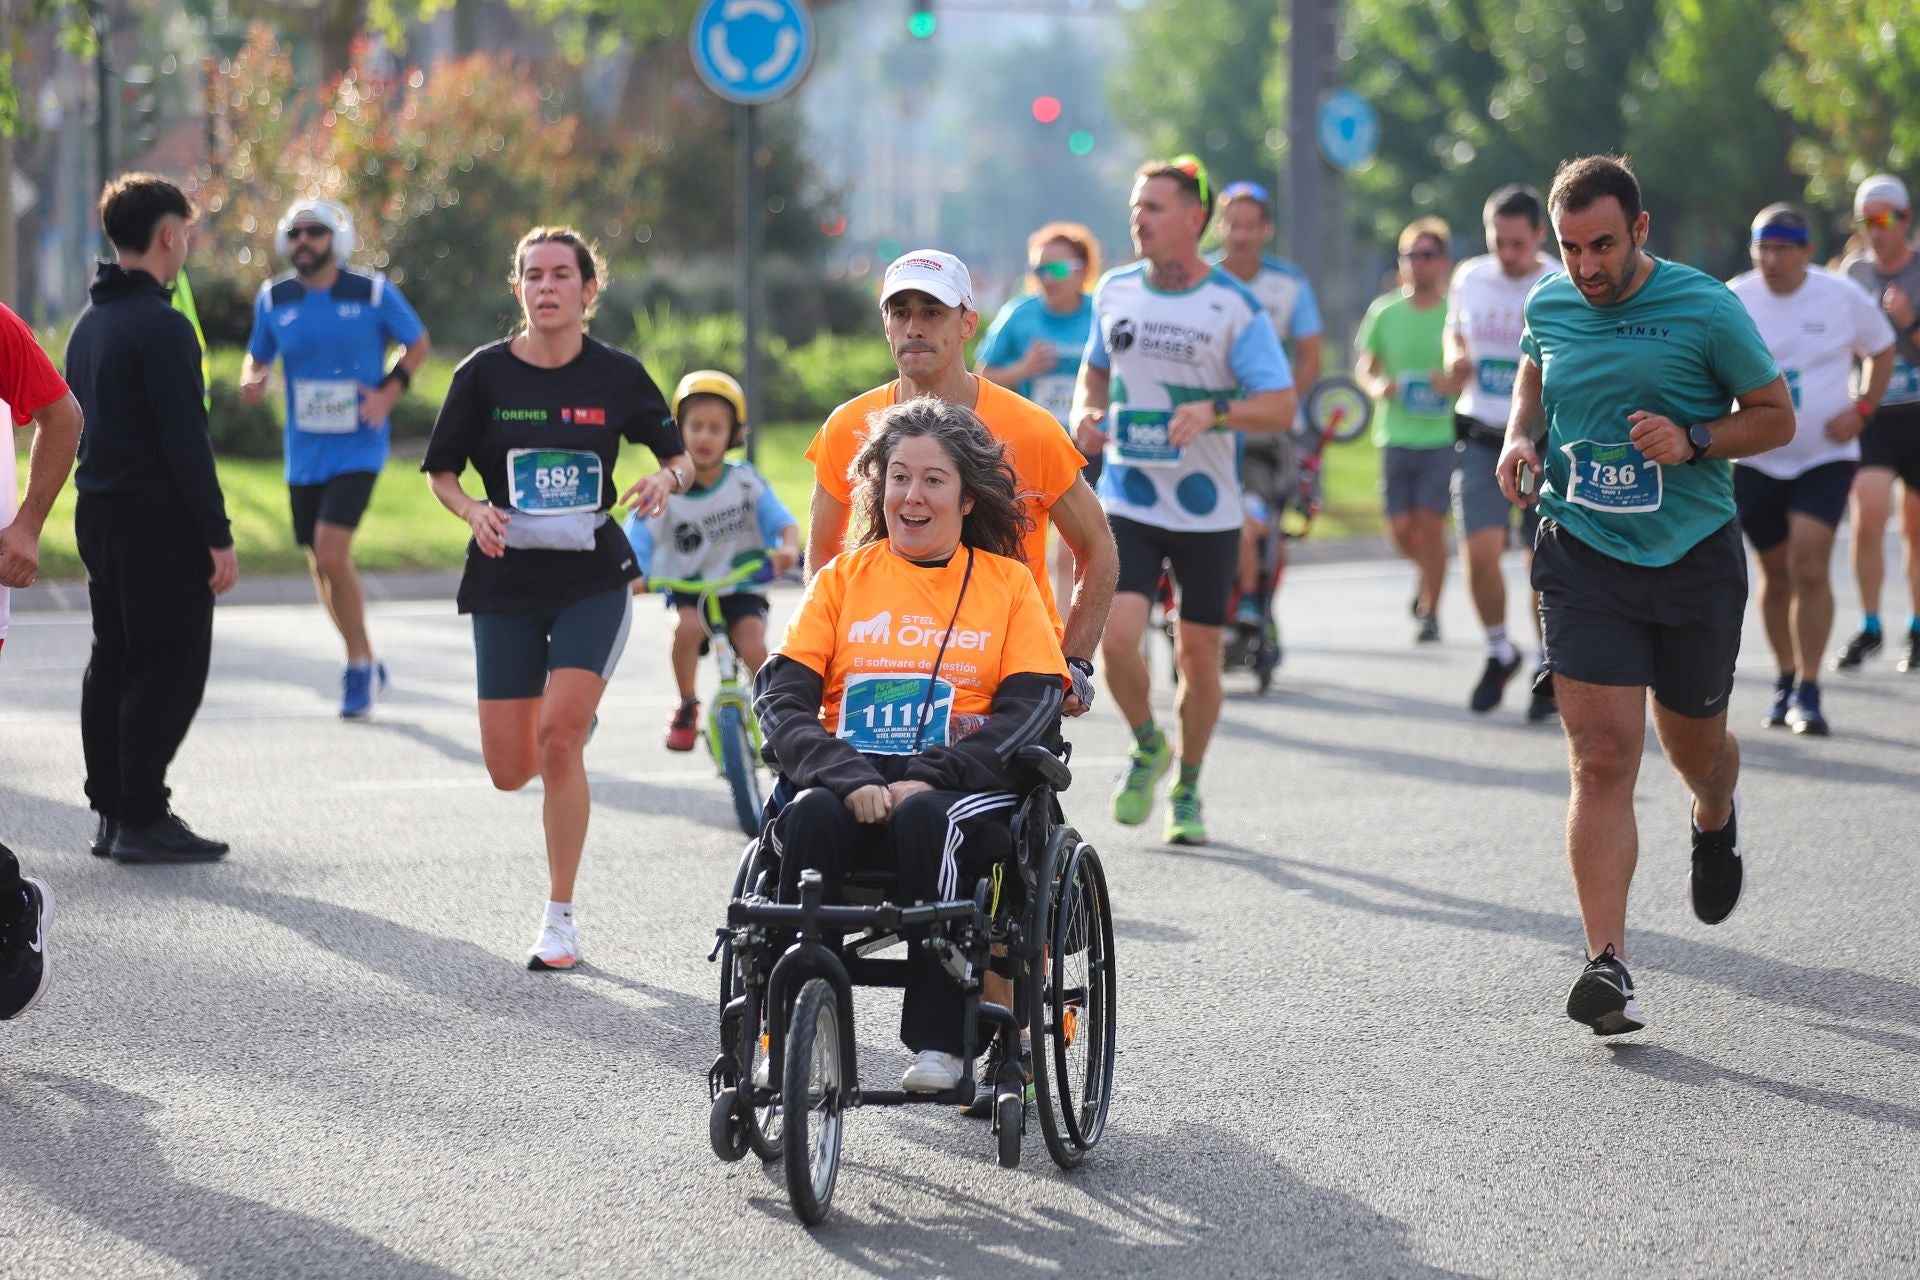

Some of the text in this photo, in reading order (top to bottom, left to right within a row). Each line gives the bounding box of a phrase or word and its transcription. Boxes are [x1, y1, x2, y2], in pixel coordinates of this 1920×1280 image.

[1616, 326, 1670, 338] KINSY
[501, 409, 548, 421] ORENES
[535, 465, 580, 491] 582
[1589, 461, 1636, 486] 736
[901, 614, 937, 626] STEL
[897, 625, 992, 651] Order
[854, 657, 977, 674] El software de estión
[863, 702, 934, 728] 1119
